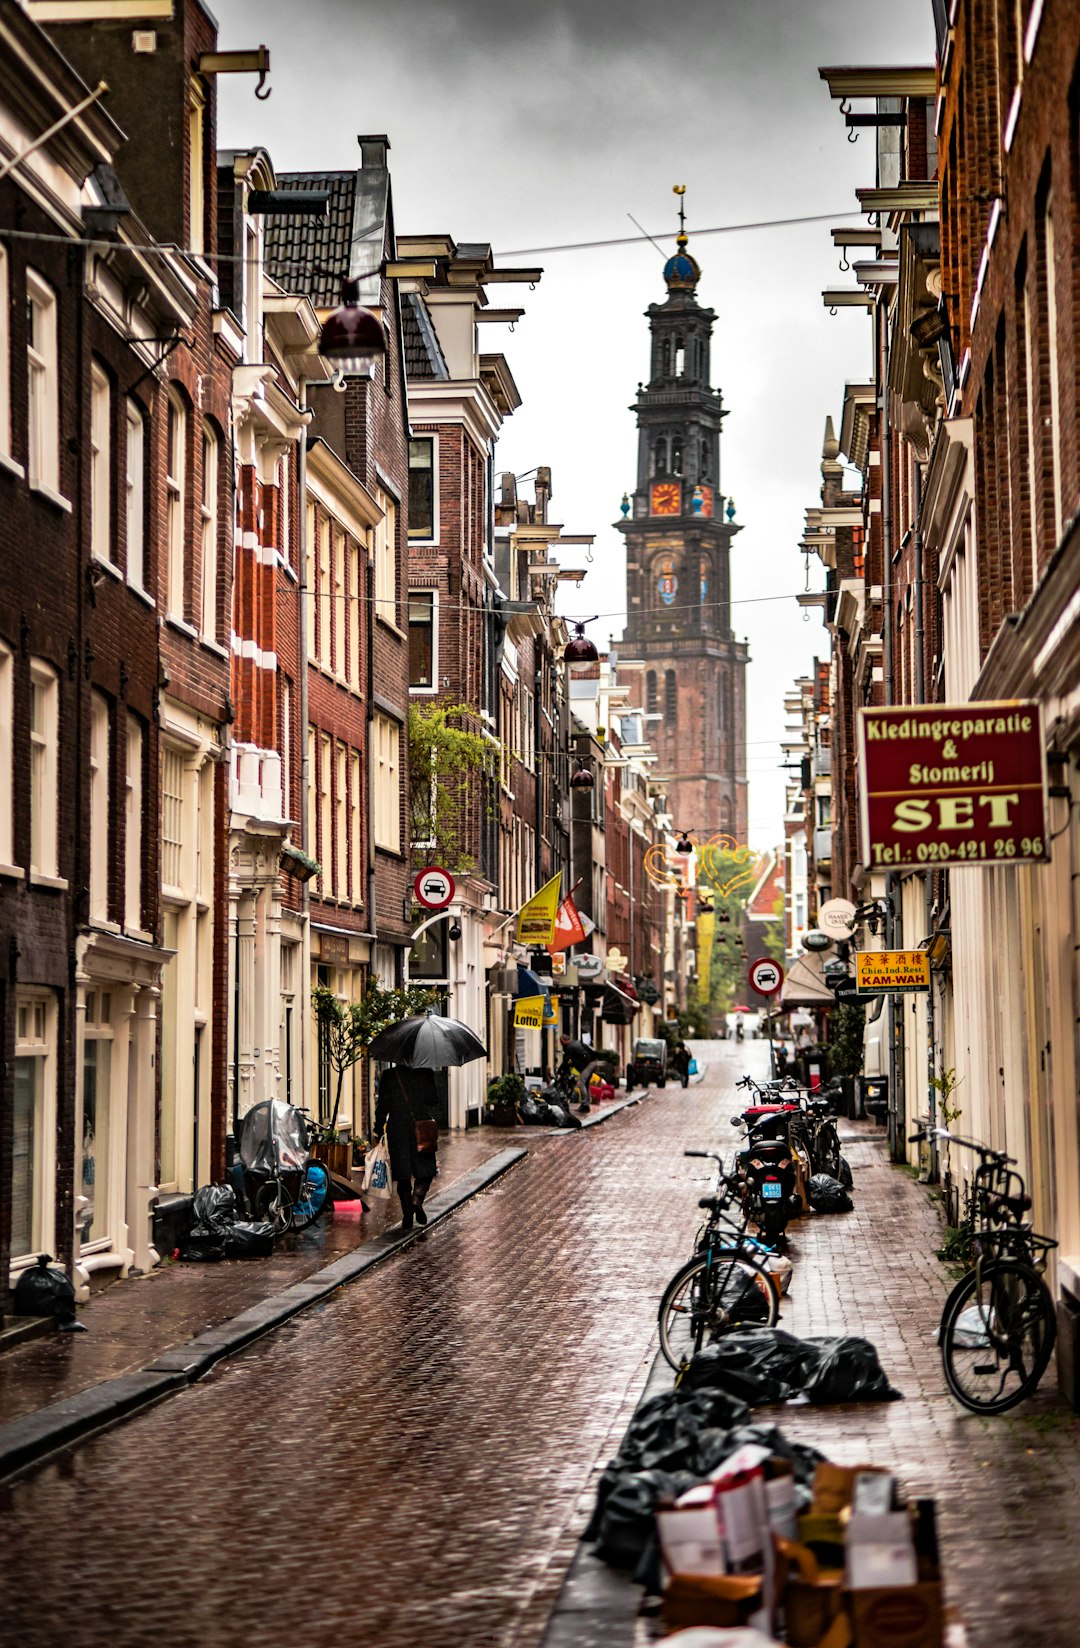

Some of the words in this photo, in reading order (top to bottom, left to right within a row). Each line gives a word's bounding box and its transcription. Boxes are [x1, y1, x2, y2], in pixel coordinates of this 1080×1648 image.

[867, 714, 1032, 741] Kledingreparatie
[942, 739, 958, 759] &
[909, 761, 994, 783] Stomerij
[891, 793, 1020, 833] SET
[872, 842, 911, 864] Tel.:
[916, 840, 986, 861] 020-421
[993, 838, 1016, 857] 26
[1020, 837, 1043, 856] 96
[862, 975, 925, 985] KAM-WAH
